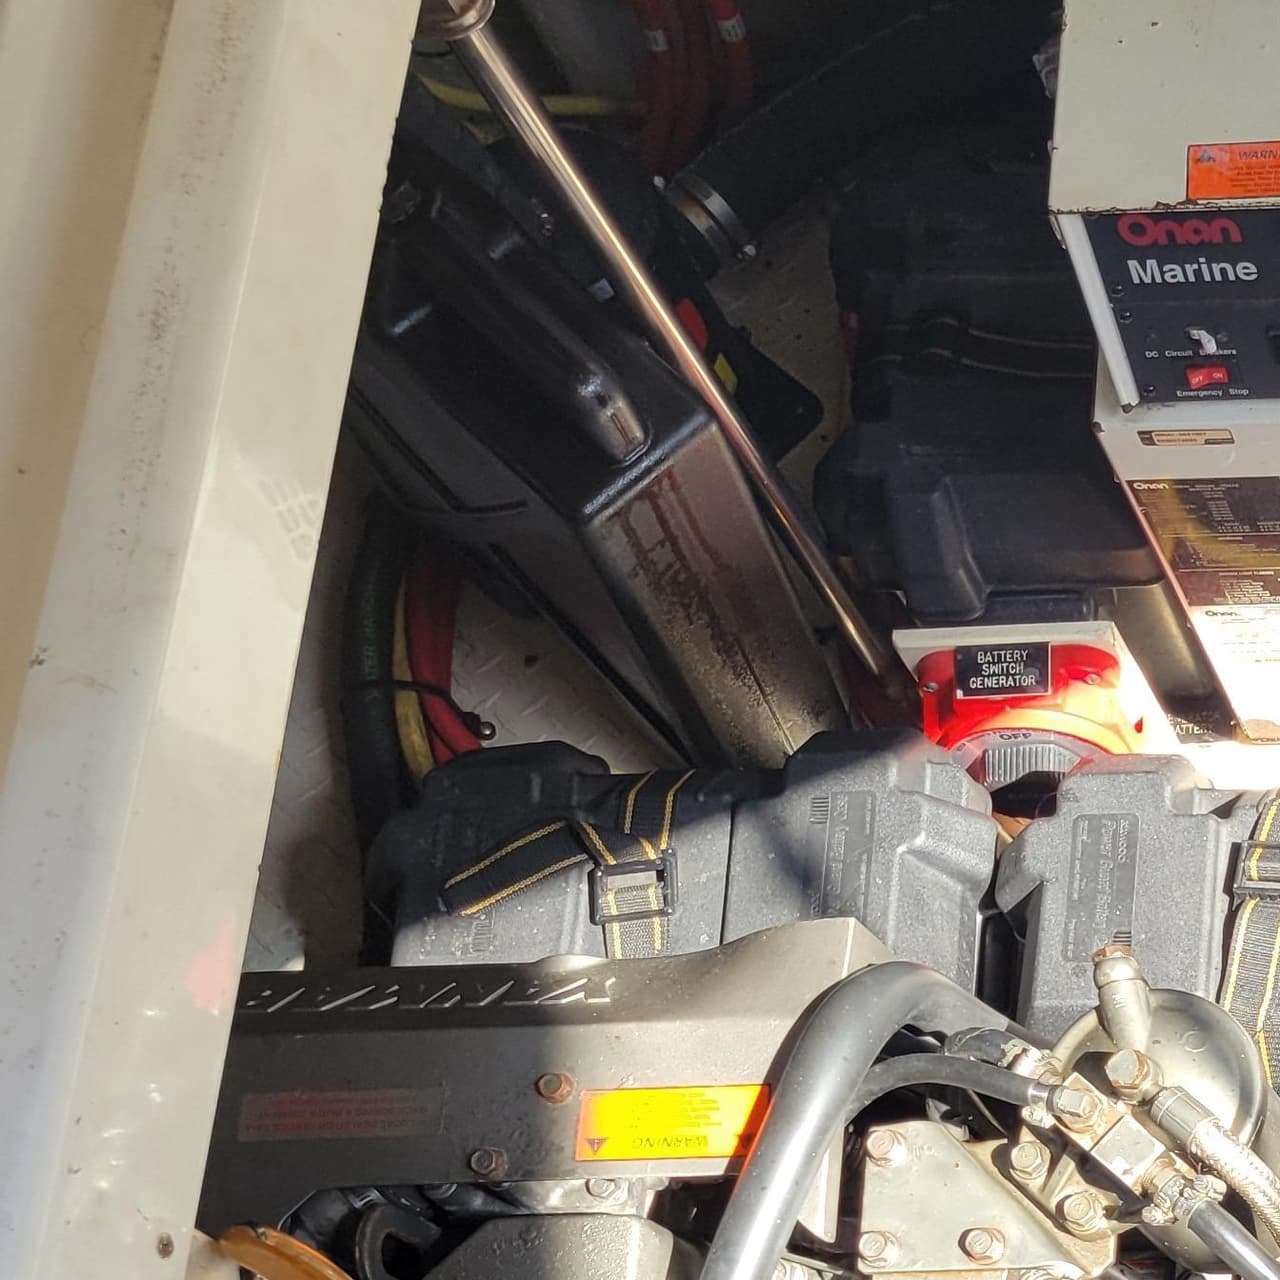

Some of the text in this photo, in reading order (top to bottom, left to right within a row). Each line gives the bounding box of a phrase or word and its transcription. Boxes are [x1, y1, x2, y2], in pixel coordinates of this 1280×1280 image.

[1116, 214, 1242, 248] Onan
[1127, 258, 1260, 285] Marine
[1165, 350, 1193, 358] Circuit
[1176, 388, 1249, 398] Emergency Stop
[1133, 482, 1169, 490] Onan
[977, 649, 1028, 663] BATTERY
[982, 663, 1024, 676] SWITCH
[969, 674, 1036, 689] GENERATOR
[999, 731, 1032, 742] OFF
